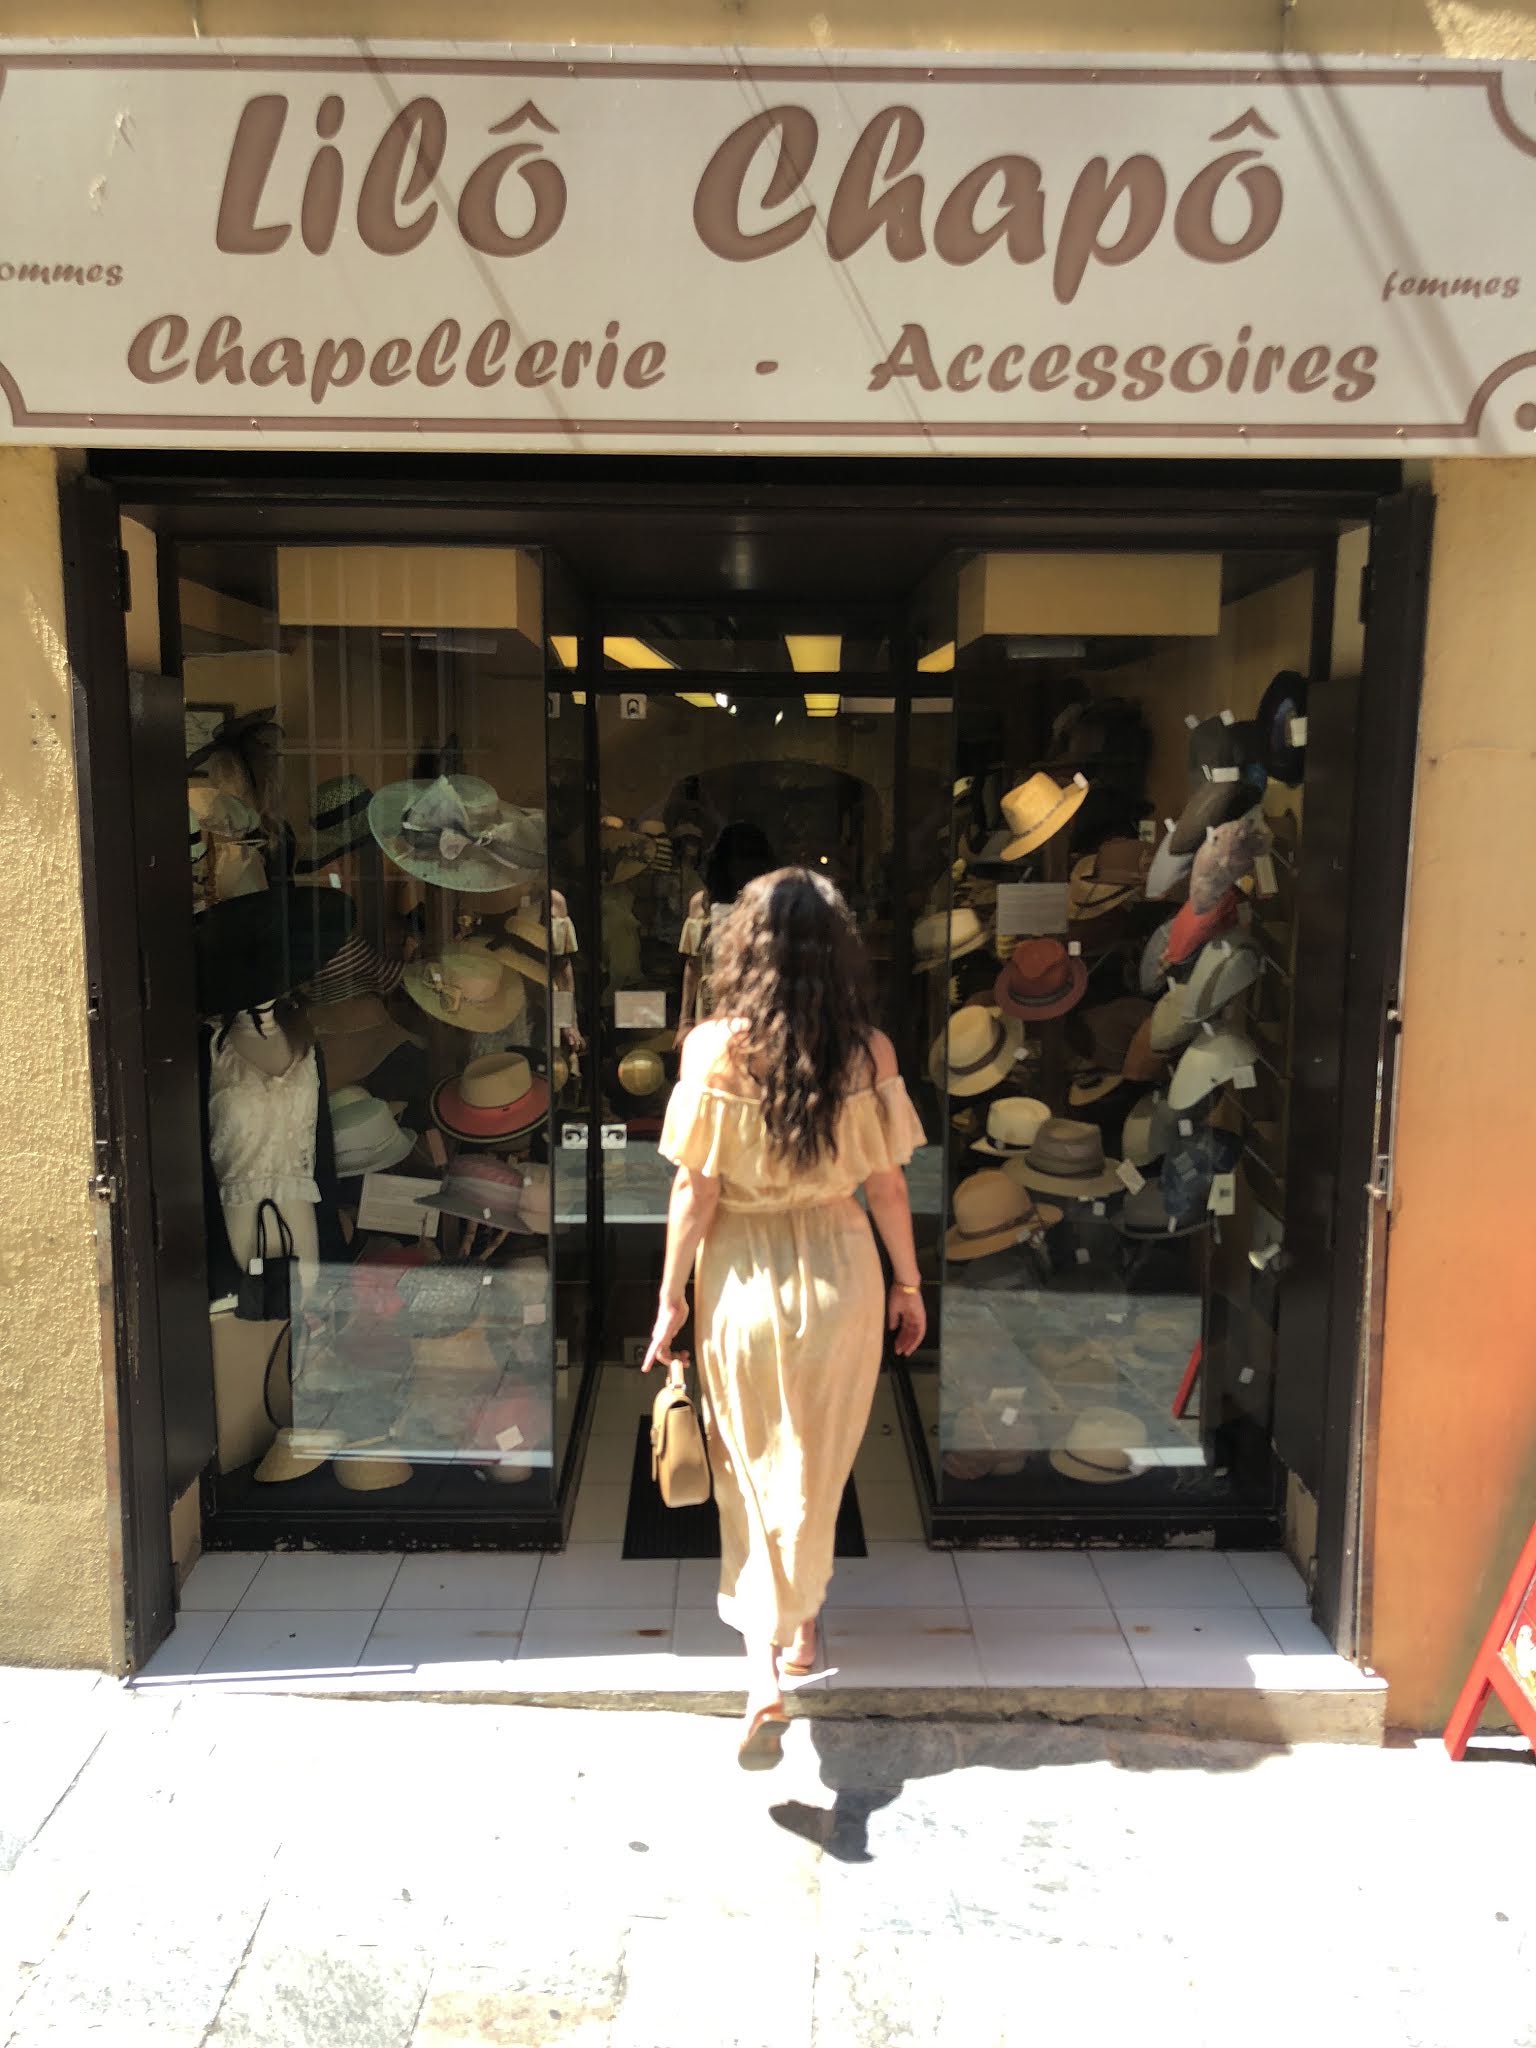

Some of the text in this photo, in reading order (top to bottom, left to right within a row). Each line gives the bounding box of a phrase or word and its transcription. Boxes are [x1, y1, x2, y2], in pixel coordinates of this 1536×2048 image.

[214, 94, 1284, 306] Lilô Chapô
[0, 262, 124, 287] ommes
[1380, 269, 1520, 303] femmes
[126, 313, 668, 405] Chapellerie
[866, 323, 1379, 402] Accessoires
